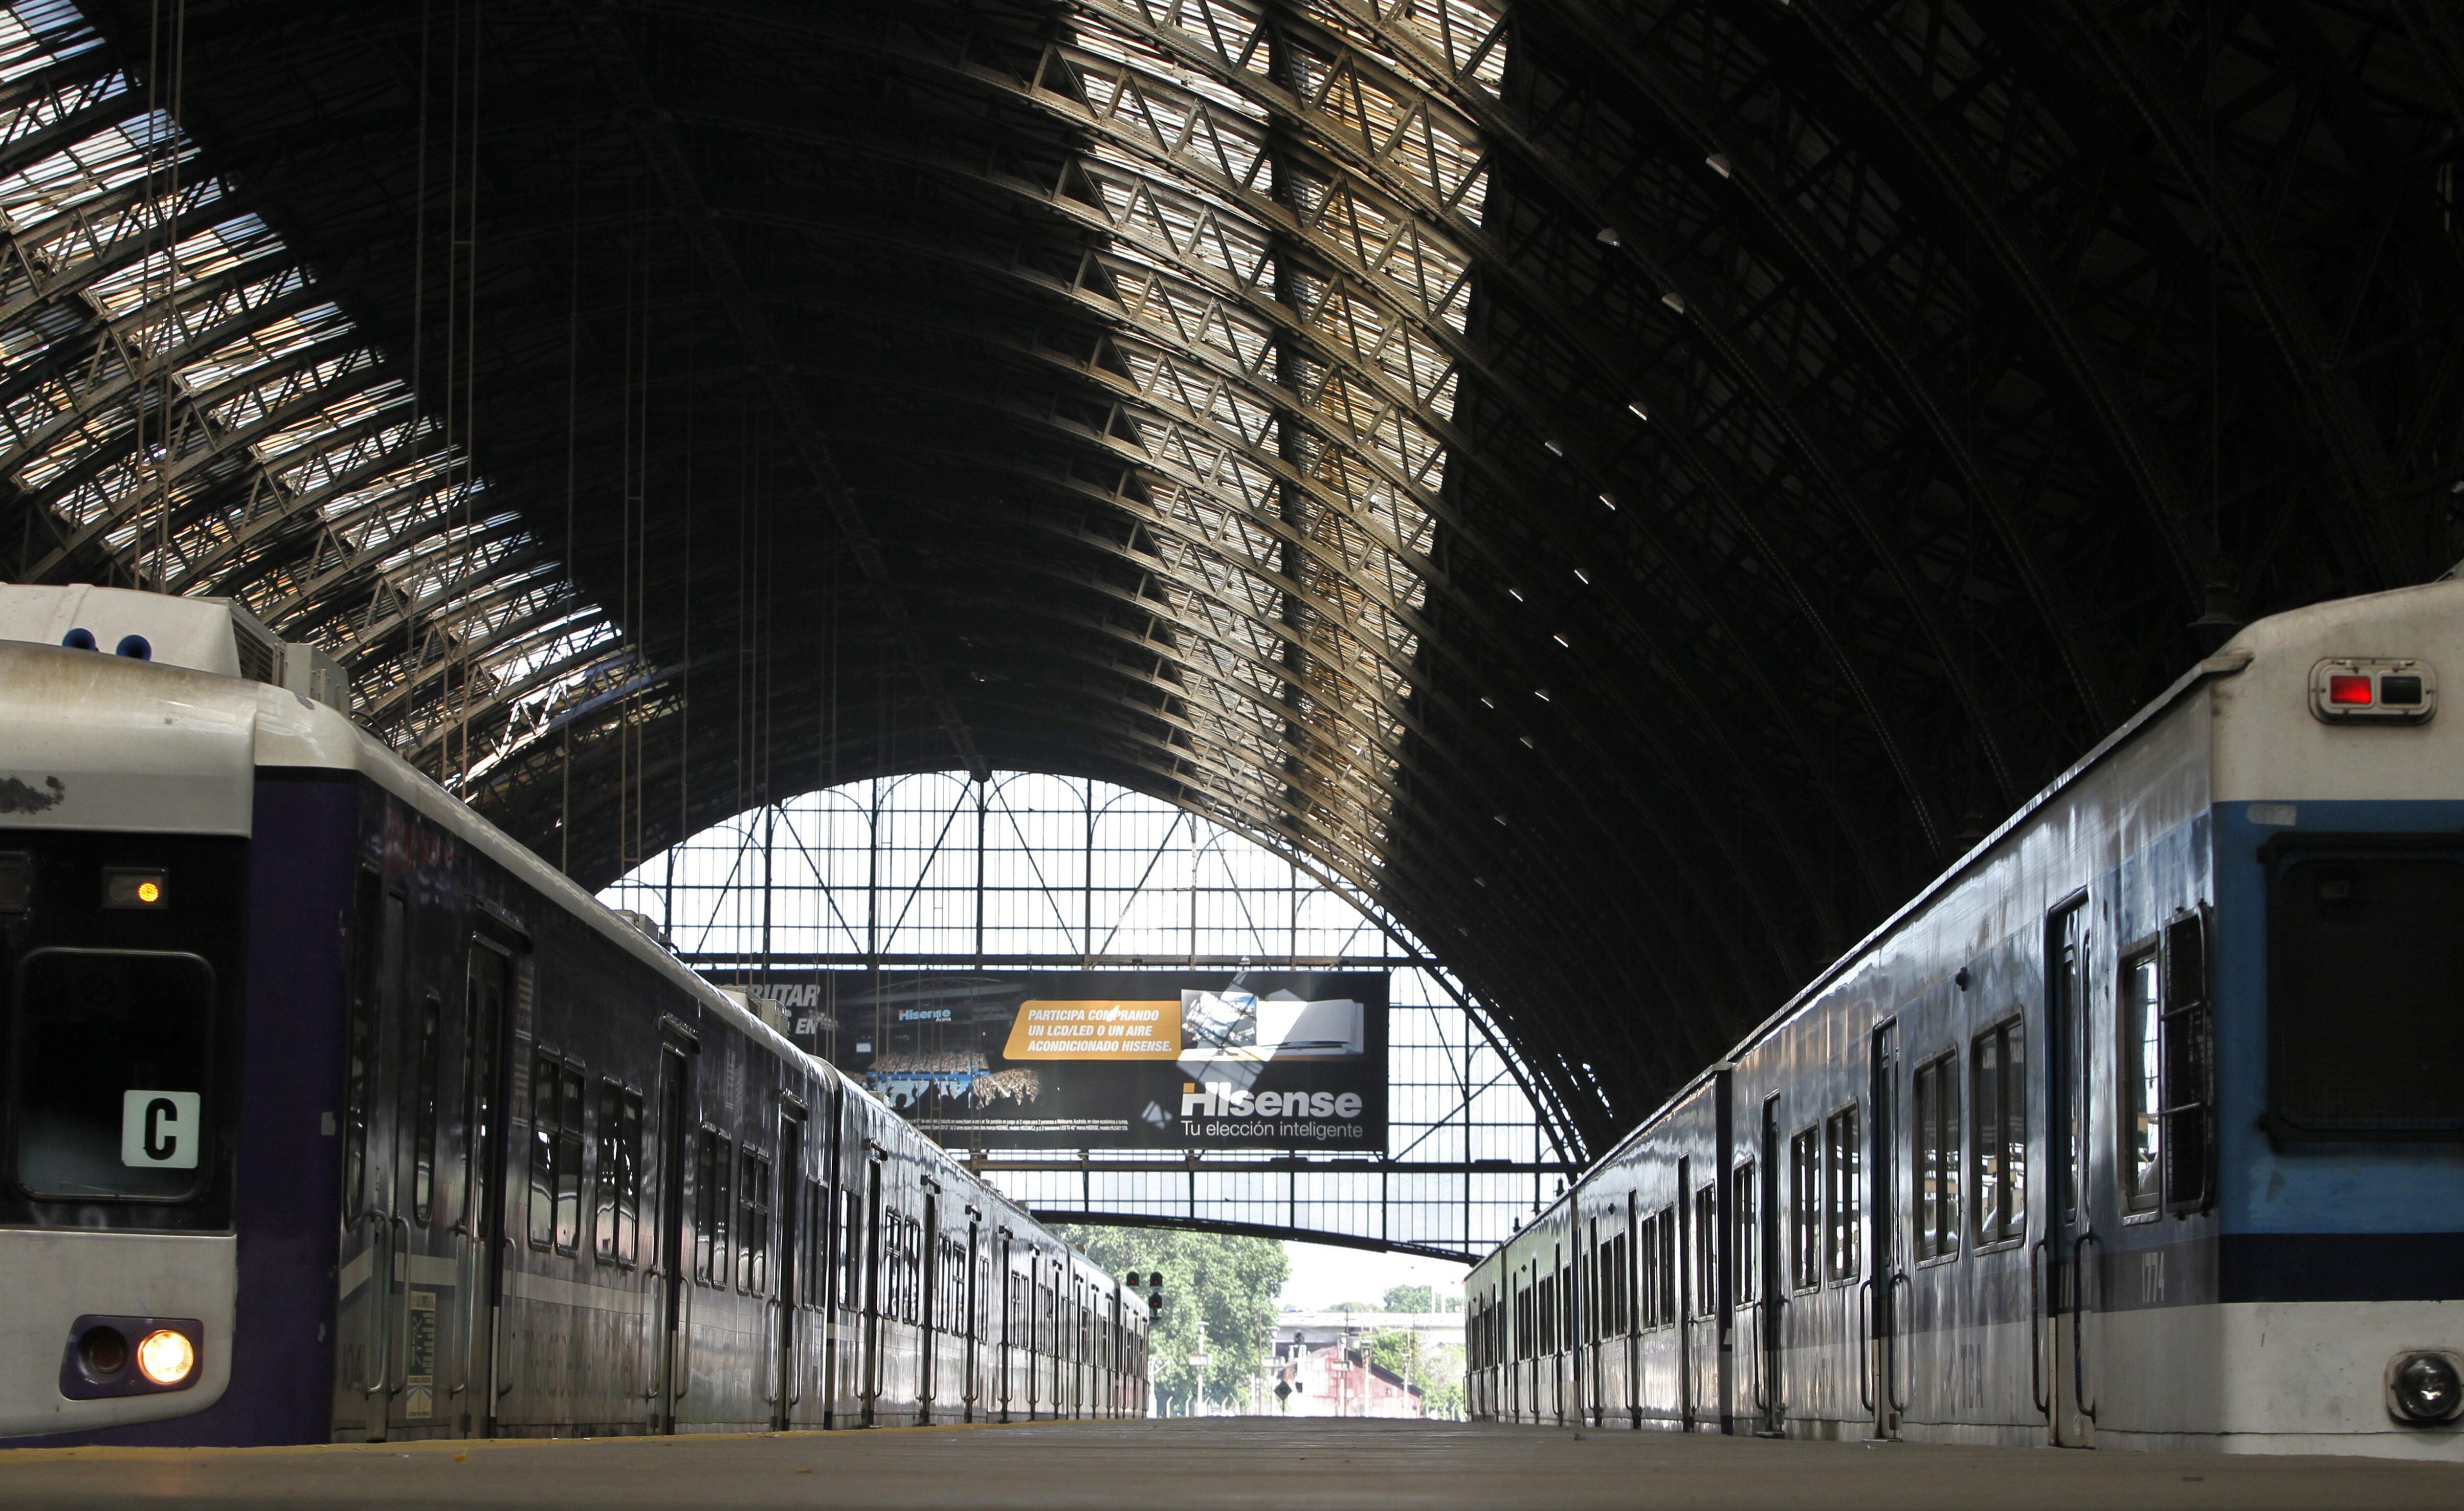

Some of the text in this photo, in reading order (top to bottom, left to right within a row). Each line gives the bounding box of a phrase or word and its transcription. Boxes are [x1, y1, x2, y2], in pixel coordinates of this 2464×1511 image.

[899, 1009, 951, 1021] Hisense
[1028, 1010, 1085, 1021] PARTICIPA
[1028, 1025, 1153, 1036] UN LCD/LED O UN AIRE
[1027, 1040, 1172, 1052] ACONDICIONADO HISENSE.
[1181, 1082, 1363, 1118] Hisense
[144, 1098, 177, 1160] C
[1180, 1120, 1363, 1141] Tu elección inteligente
[1960, 1343, 1984, 1409] TBA
